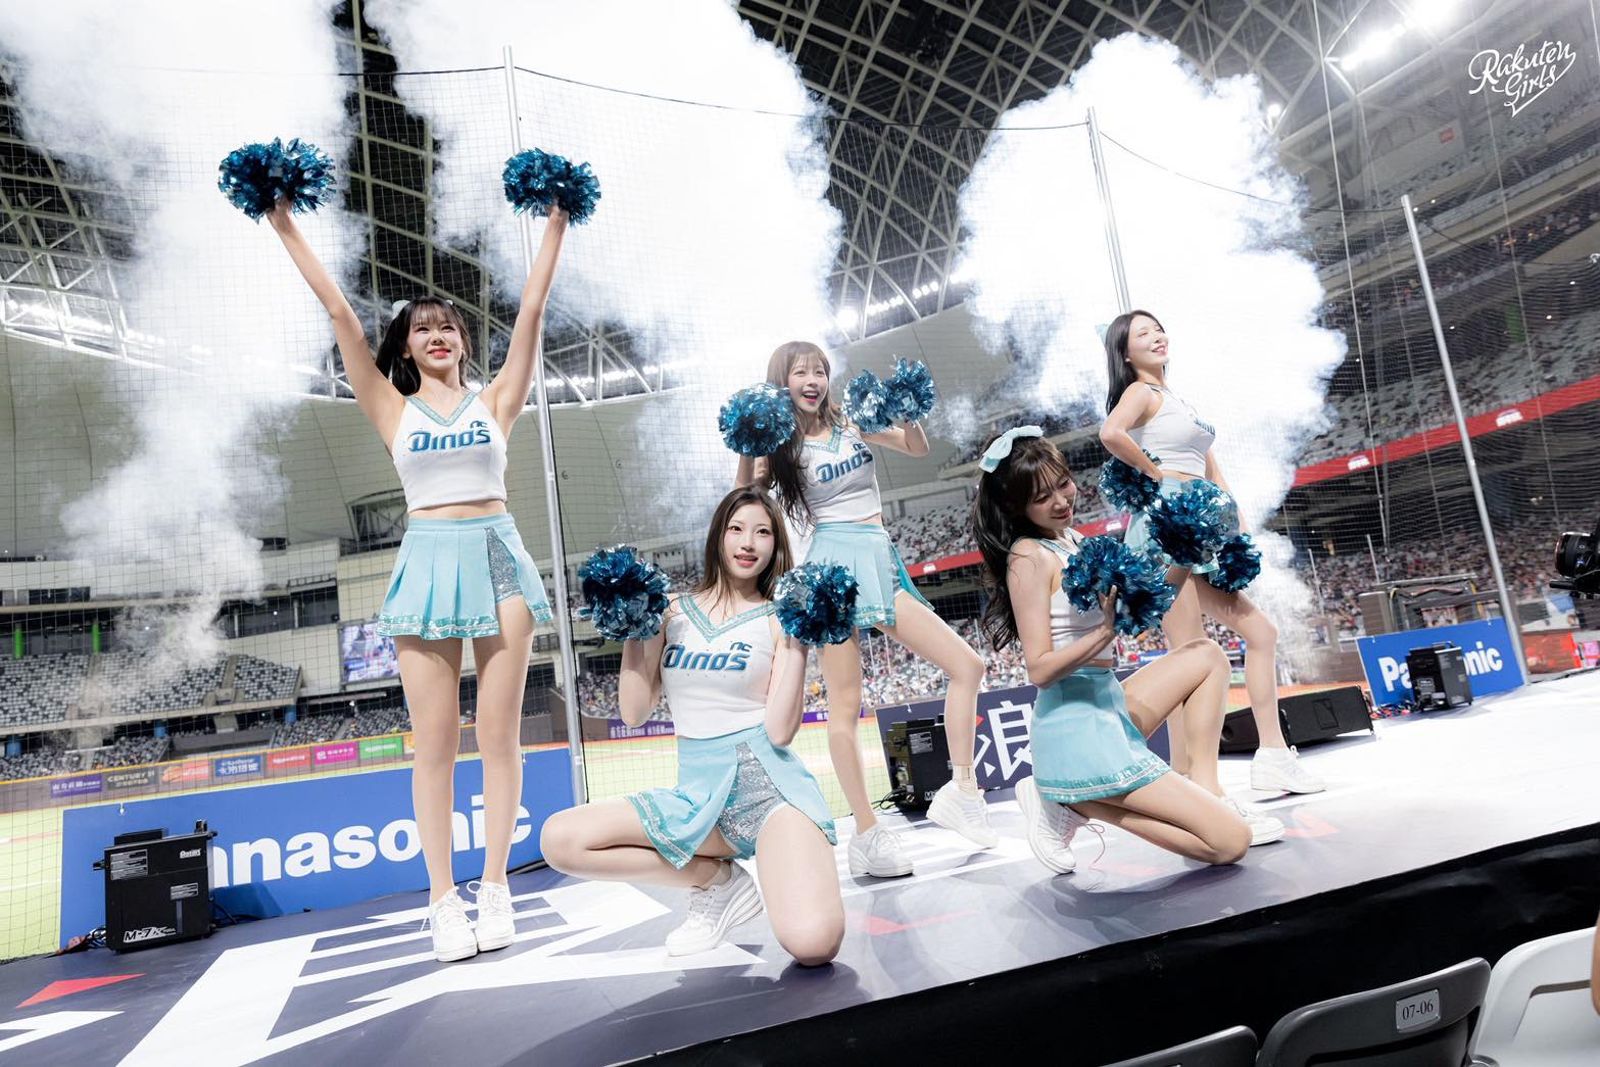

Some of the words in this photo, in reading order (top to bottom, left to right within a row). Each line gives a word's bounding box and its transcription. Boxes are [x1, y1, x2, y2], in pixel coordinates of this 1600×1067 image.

[1377, 641, 1504, 692] Panic
[212, 794, 532, 888] nasoic
[1402, 1000, 1434, 1020] 07-06
